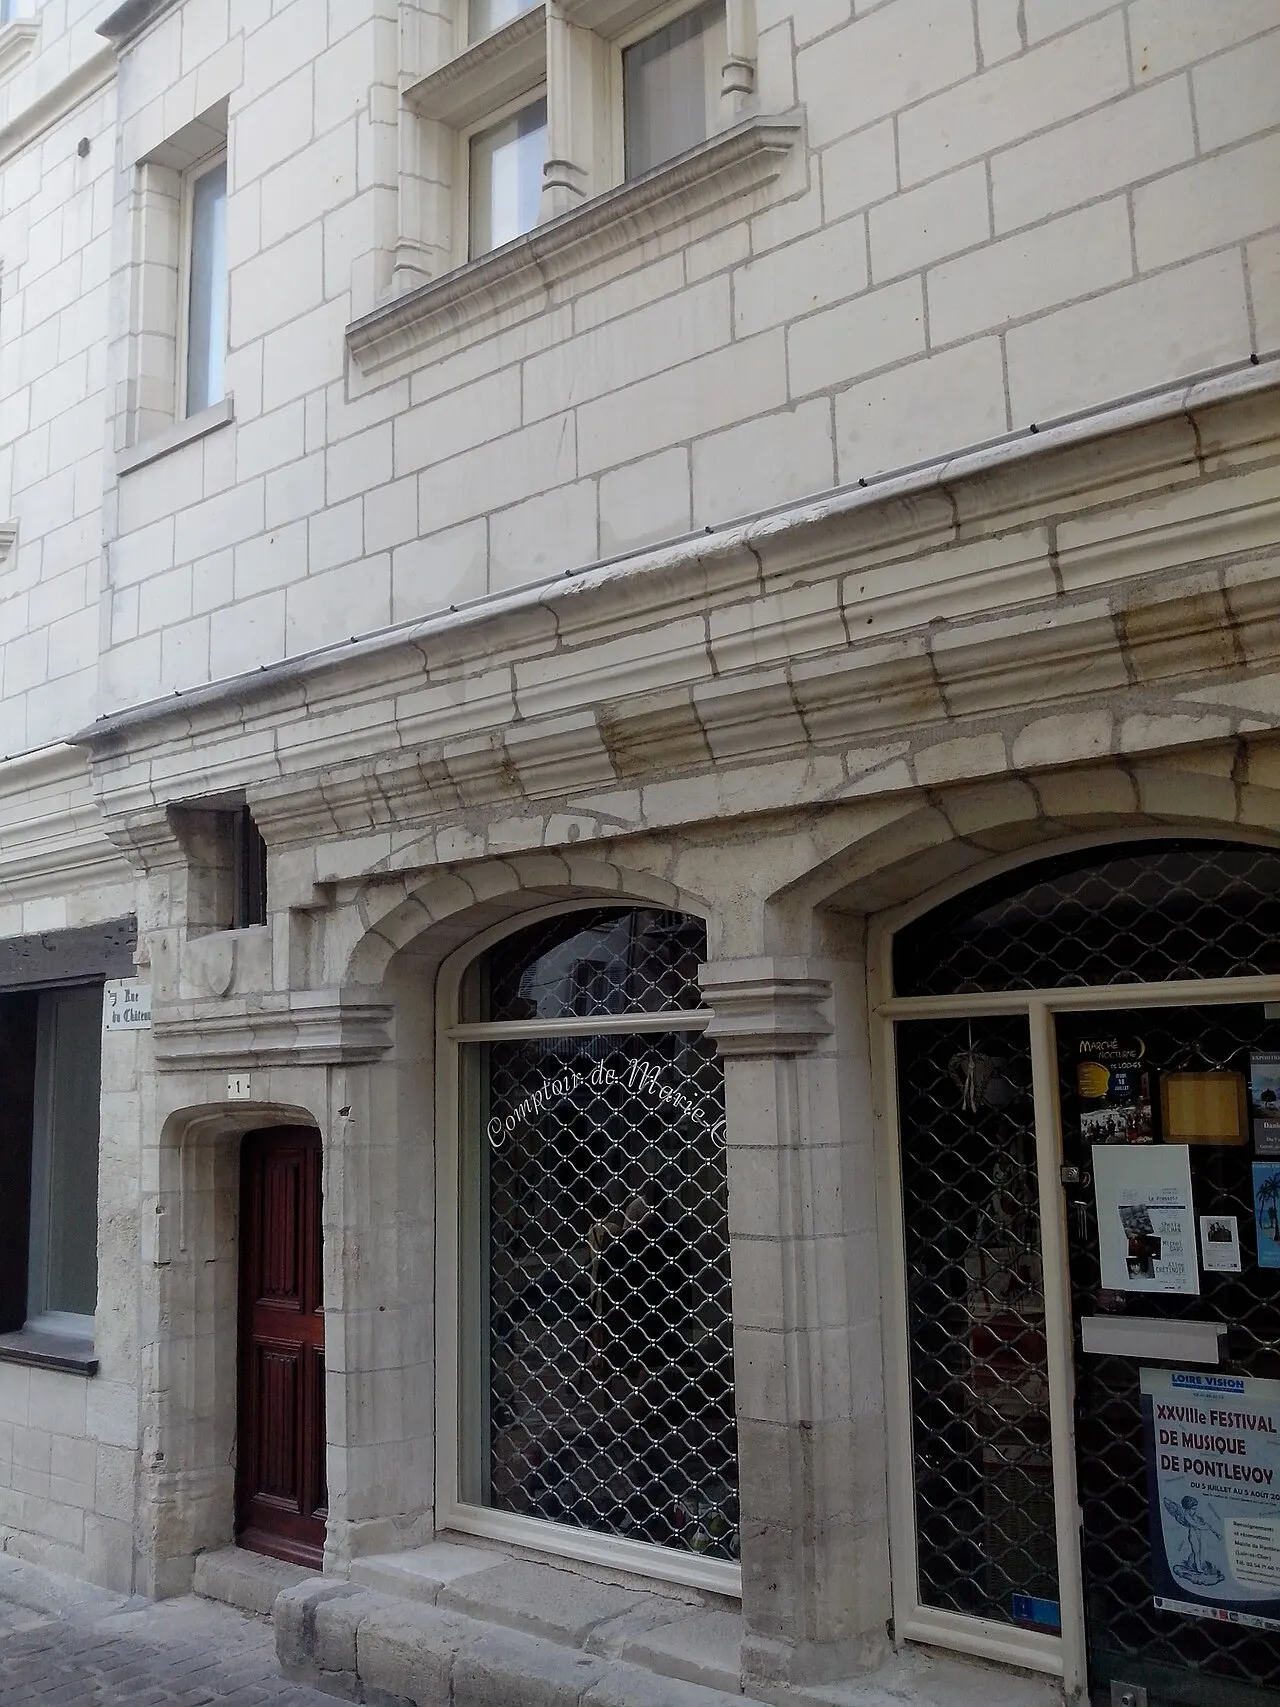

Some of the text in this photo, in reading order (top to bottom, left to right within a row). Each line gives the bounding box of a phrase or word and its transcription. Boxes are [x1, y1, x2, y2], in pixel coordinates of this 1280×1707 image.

[124, 988, 139, 1003] Rue
[112, 1011, 121, 1023] du
[236, 1080, 241, 1094] 1
[487, 1072, 582, 1148] Comptoir
[591, 1058, 616, 1085] de
[1171, 1373, 1202, 1385] LOIRE
[1205, 1376, 1244, 1389] VISION
[1156, 1403, 1278, 1433] XXVIIIe FESTIVAL
[1159, 1429, 1247, 1456] DE MUSIQUE
[1160, 1454, 1274, 1485] DE PONTLEVOY
[1207, 1484, 1231, 1494] JUILLET
